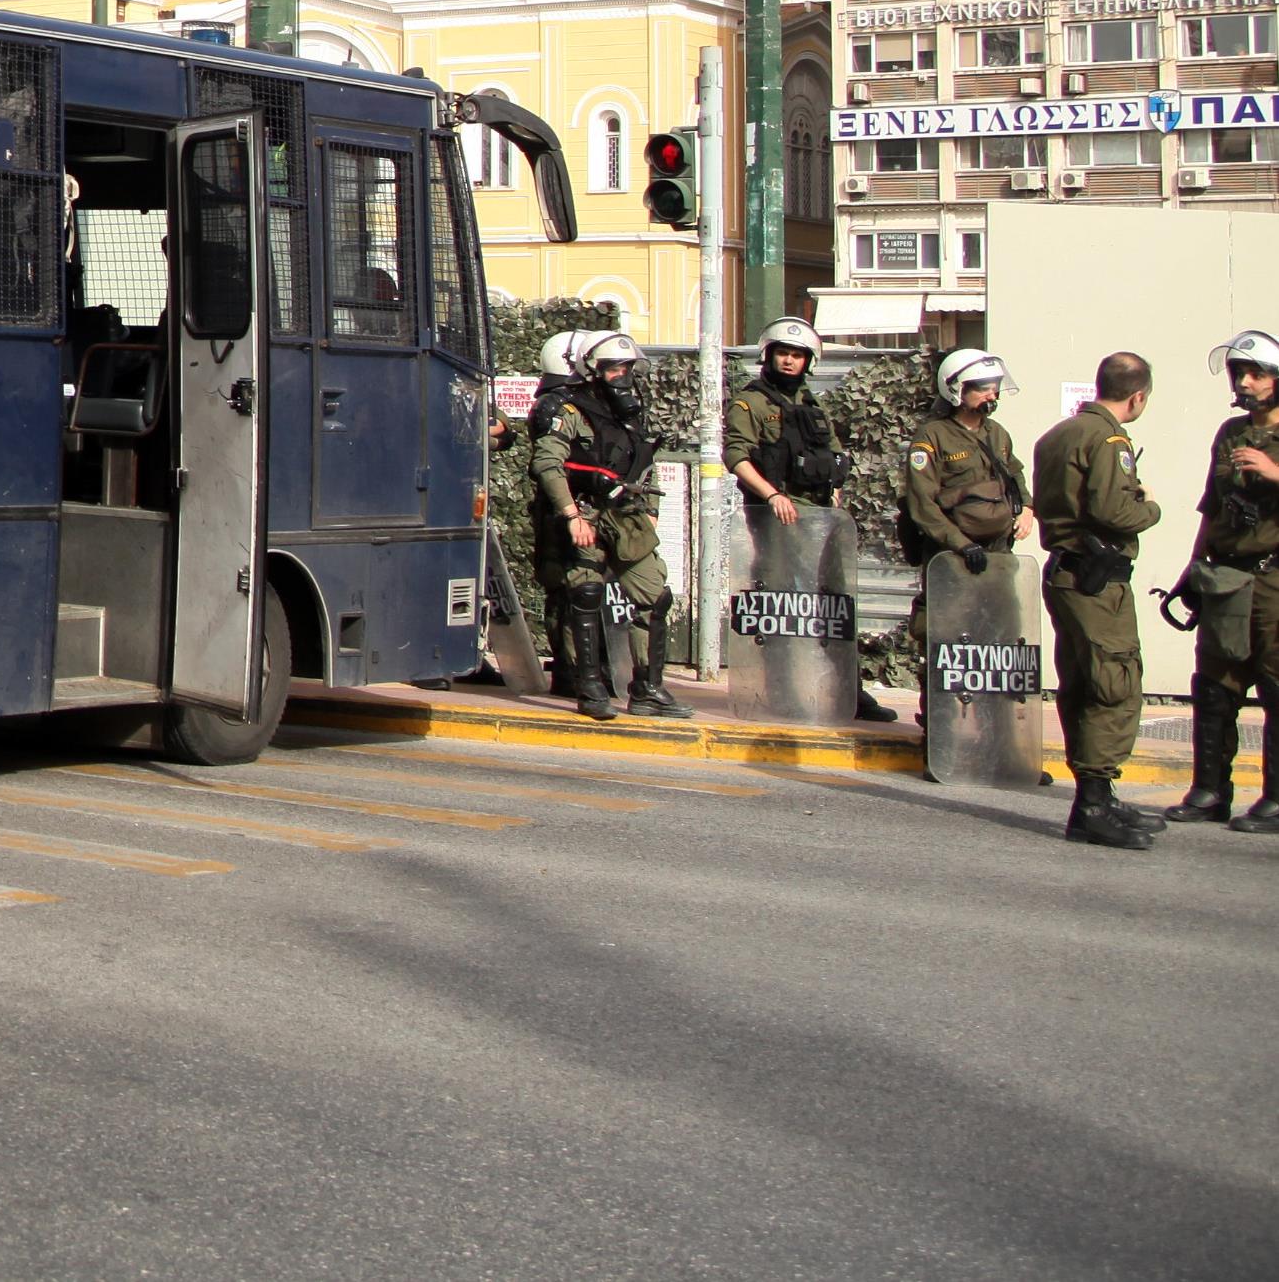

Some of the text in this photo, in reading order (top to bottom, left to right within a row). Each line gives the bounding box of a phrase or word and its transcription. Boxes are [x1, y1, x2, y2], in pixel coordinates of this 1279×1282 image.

[855, 0, 1043, 28] ΒΙΟΤΕΧΝΙΚΟΝ
[837, 108, 955, 137] ΞΕΝΕΣ
[969, 101, 1142, 131] ΓΛΩΣΣΕΣ
[496, 392, 531, 400] ATHENS
[496, 400, 539, 408] ECURITY
[736, 591, 849, 620] ΑΣΤΥΝΟΜΙΑ
[741, 615, 844, 638] POLICE
[936, 644, 1038, 670] ΑΣΤΥΝΟΜΙΑ
[943, 670, 1035, 691] POLICE
